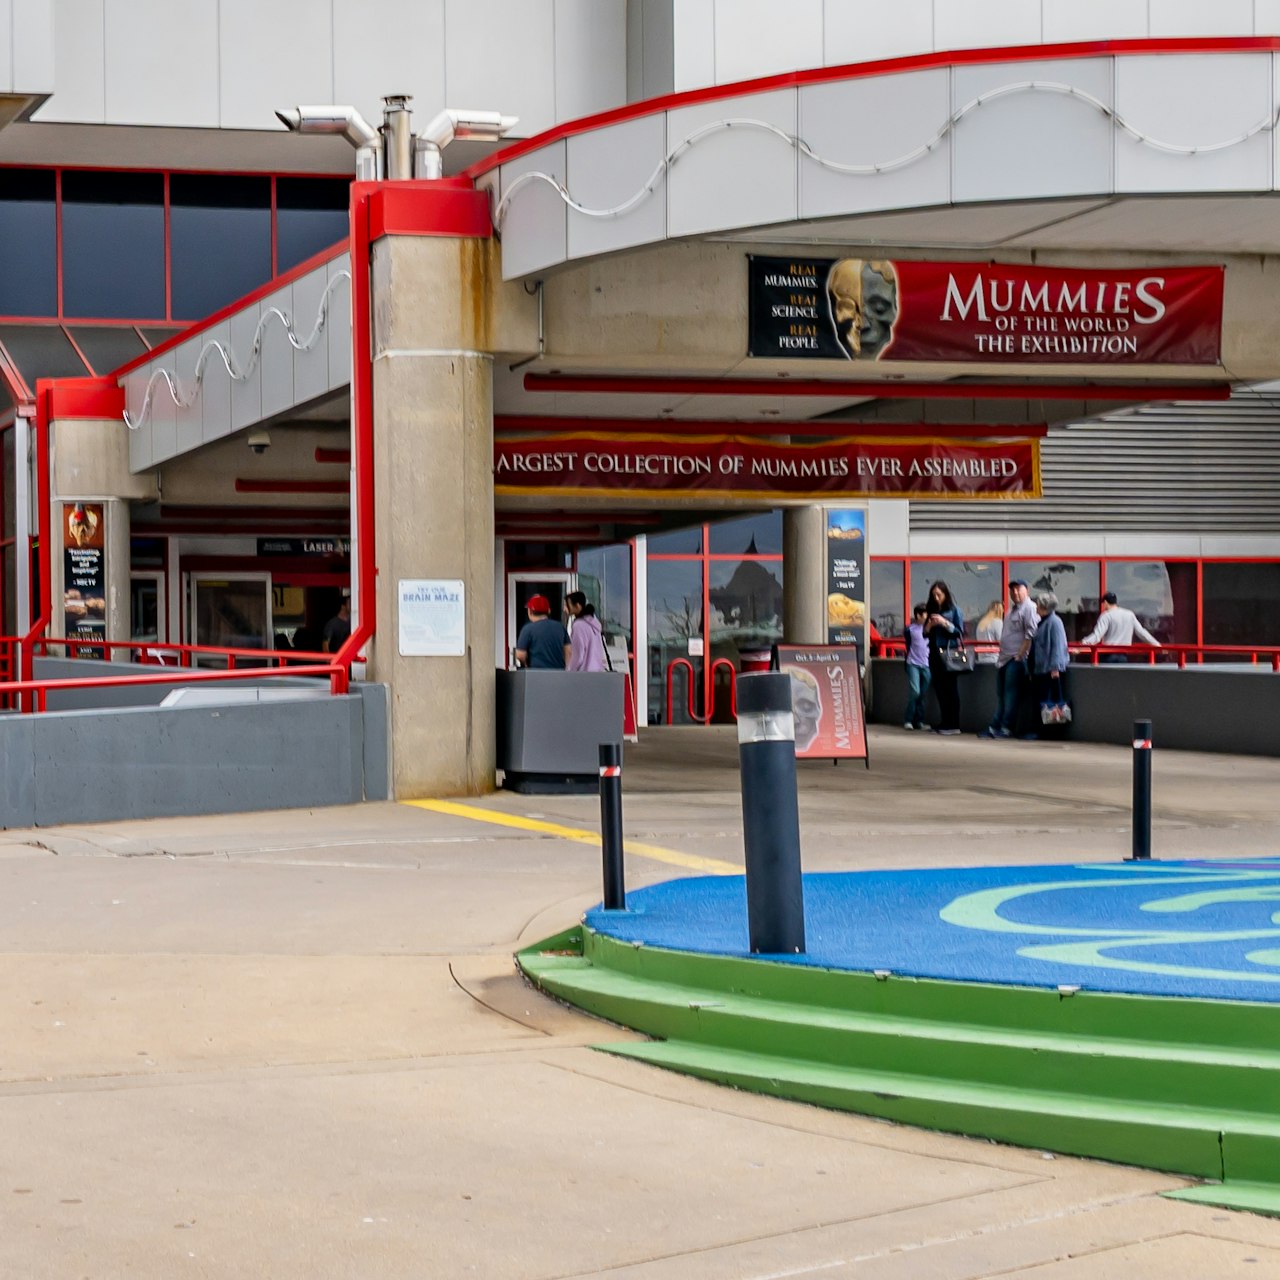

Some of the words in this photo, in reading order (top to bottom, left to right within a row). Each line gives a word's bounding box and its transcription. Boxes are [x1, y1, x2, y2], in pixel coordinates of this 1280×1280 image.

[939, 272, 1166, 324] MUMMIES
[995, 316, 1018, 331] OF
[1024, 316, 1059, 332] THE
[1065, 317, 1130, 333] WORLD
[974, 334, 1015, 353] THE
[1021, 334, 1138, 354] EXHIBITION
[494, 452, 578, 474] ARGEST
[583, 453, 711, 475] COLLECTION
[718, 455, 745, 475] OF
[751, 456, 849, 477] MUMMIES
[856, 456, 904, 477] EVER
[908, 457, 1018, 478] ASSEMBLED
[403, 593, 431, 601] BRAIN
[434, 593, 459, 601] MAZE
[816, 653, 831, 663] April
[827, 665, 851, 750] MUMMIES
